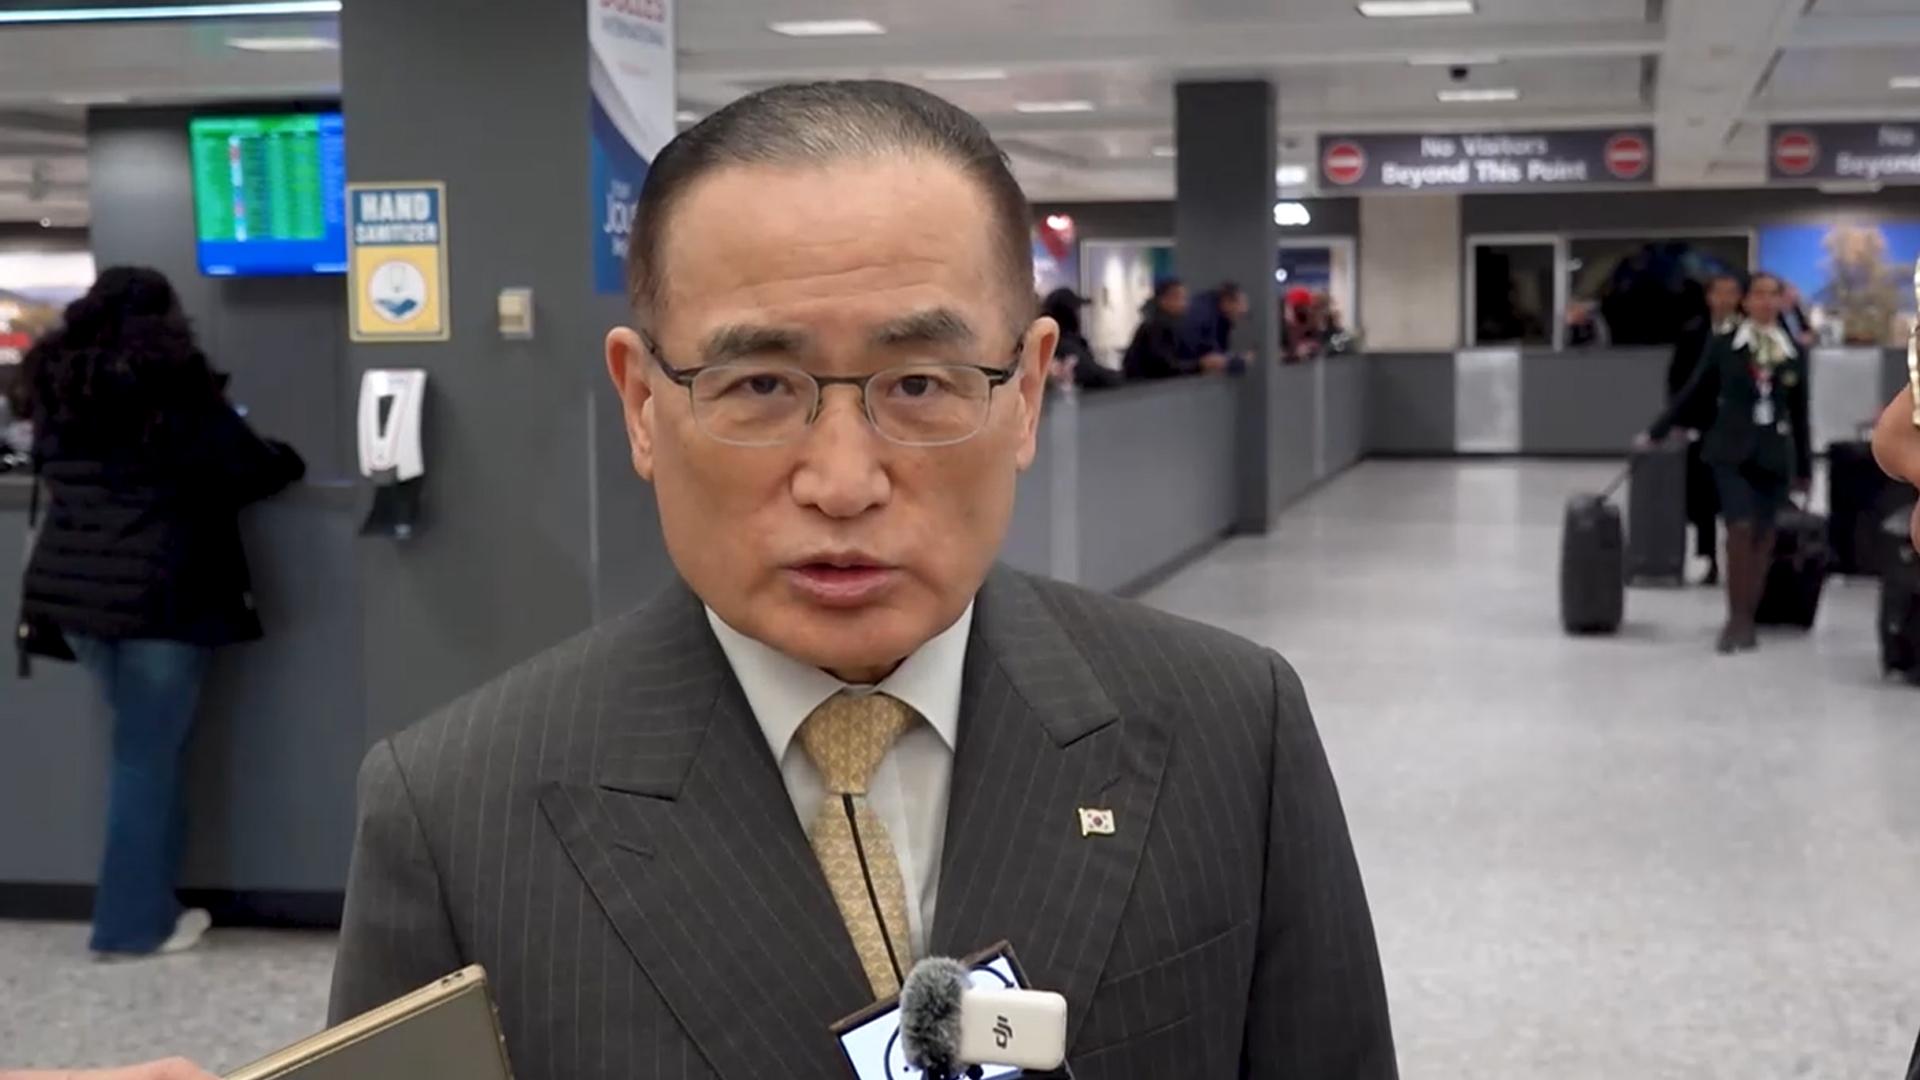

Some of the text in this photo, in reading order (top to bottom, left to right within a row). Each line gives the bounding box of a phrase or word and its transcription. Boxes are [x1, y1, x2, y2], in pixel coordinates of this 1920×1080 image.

[1421, 135, 1549, 157] No Visitors
[1381, 158, 1587, 189] Beyond This Point
[360, 192, 431, 222] HAND
[355, 223, 438, 243] SANITIZER
